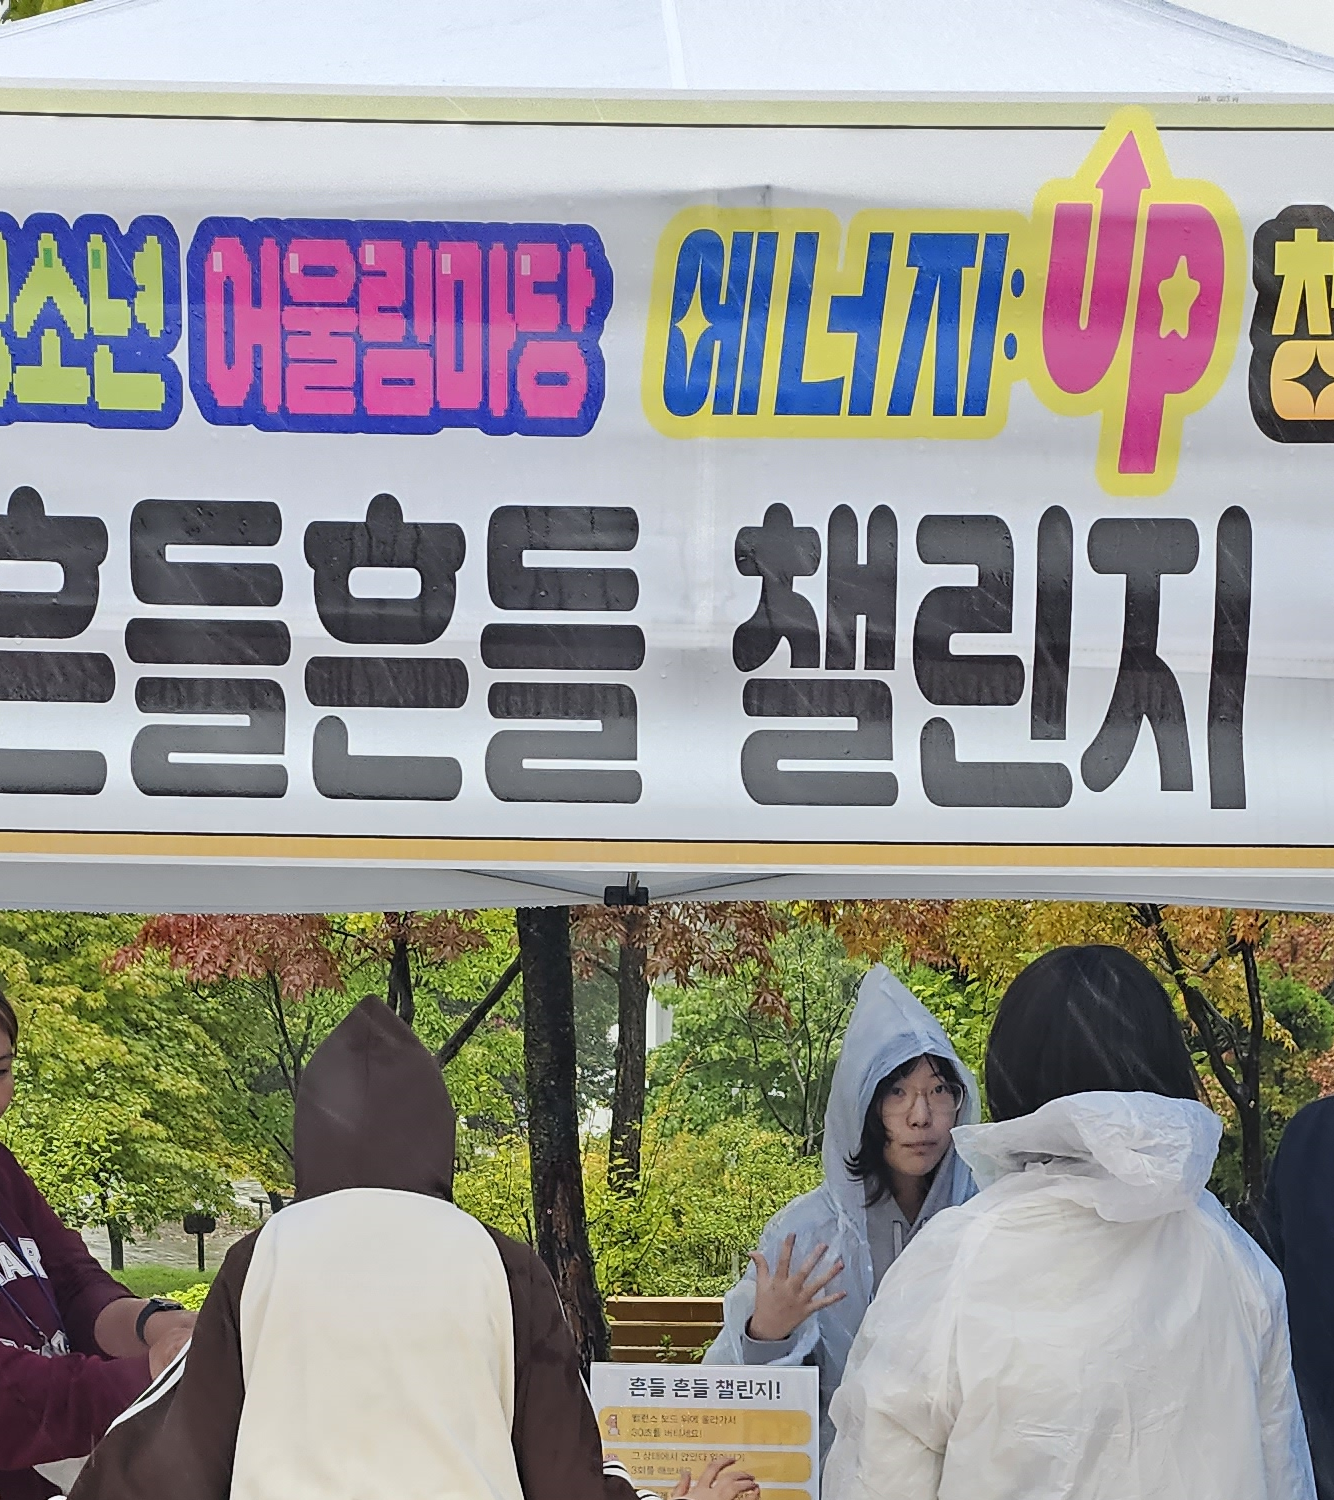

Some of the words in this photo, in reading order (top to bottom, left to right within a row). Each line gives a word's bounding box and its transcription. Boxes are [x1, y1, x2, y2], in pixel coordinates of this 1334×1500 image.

[202, 235, 597, 419] 어울림마당
[732, 501, 1253, 811] 챌린지
[629, 1376, 666, 1398] 흔들
[672, 1378, 710, 1399] 흔들
[716, 1379, 781, 1400] 챌린지!
[631, 1451, 640, 1460] 그
